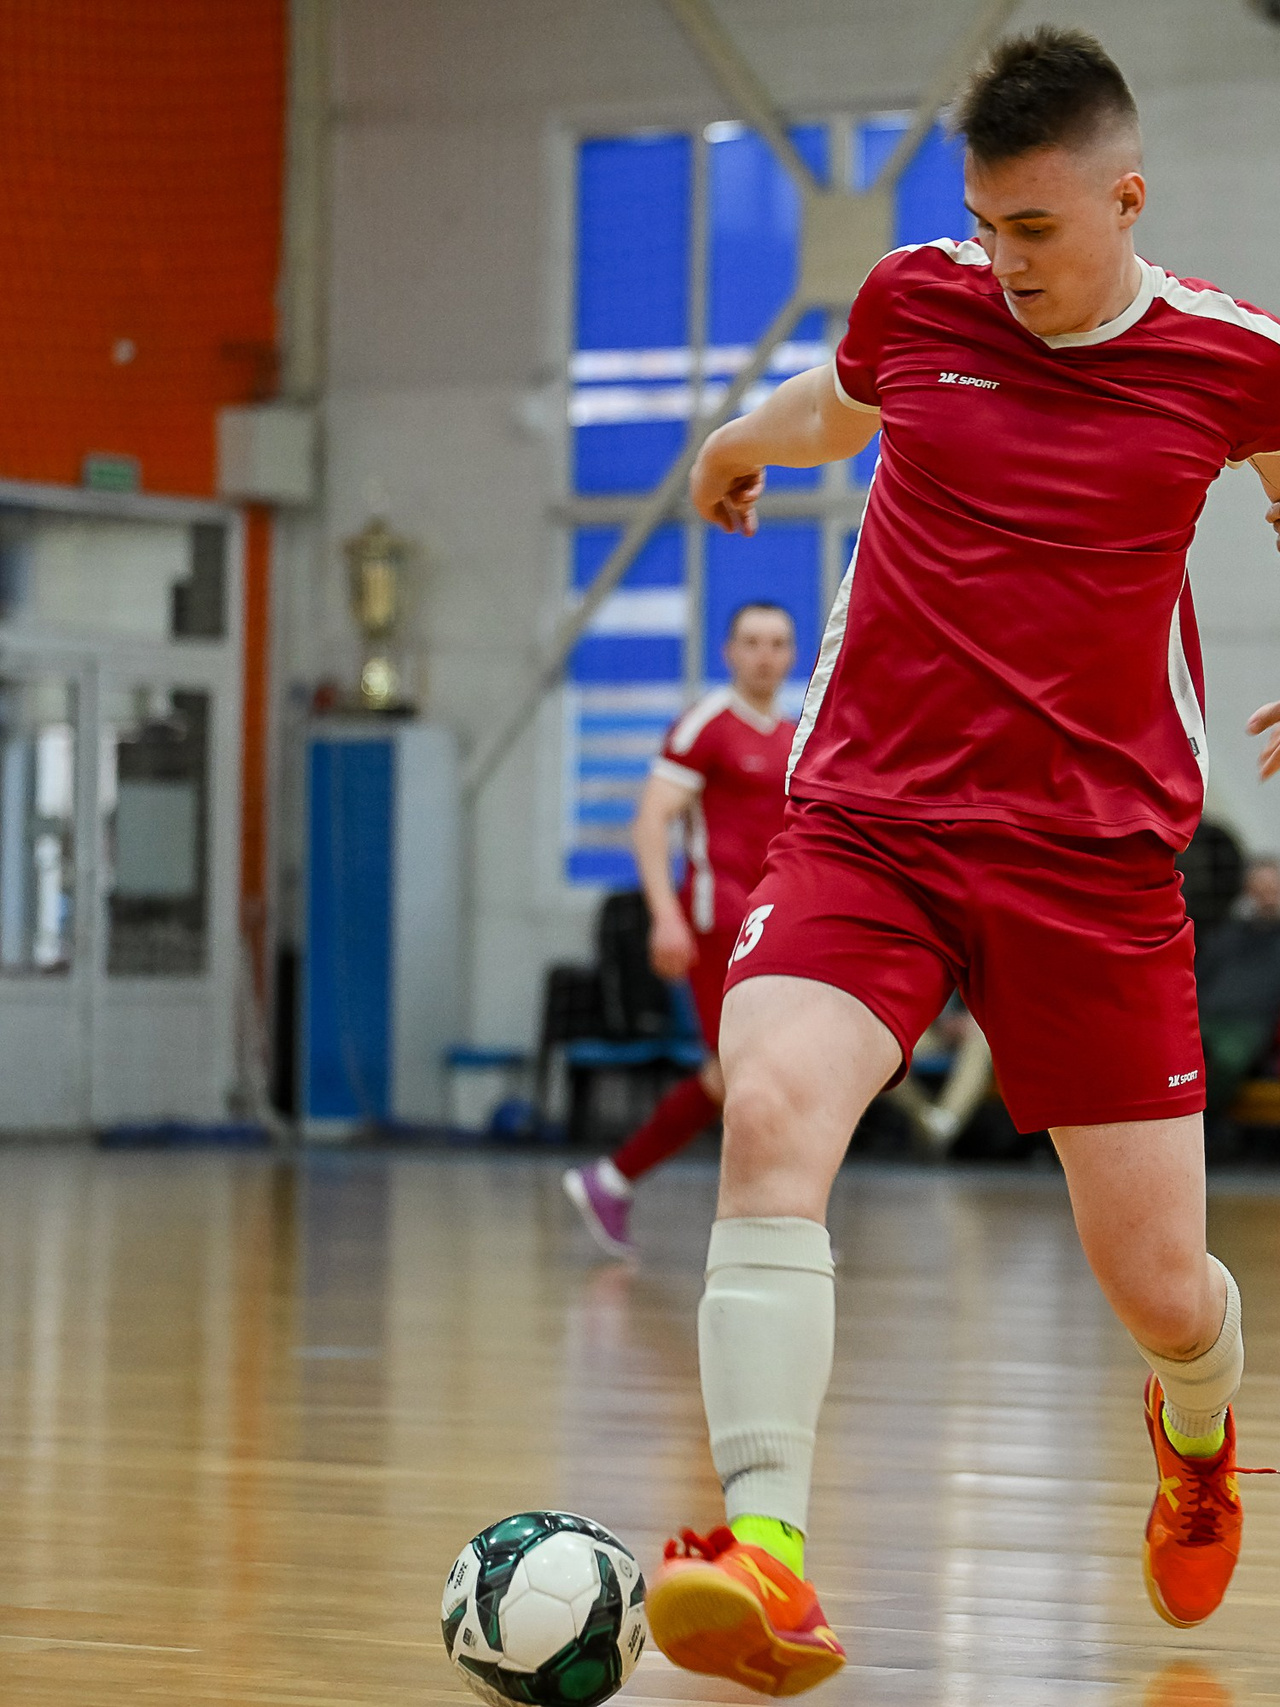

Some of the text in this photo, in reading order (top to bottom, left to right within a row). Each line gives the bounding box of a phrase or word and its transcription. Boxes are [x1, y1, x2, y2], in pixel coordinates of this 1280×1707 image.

[937, 372, 1000, 390] 2K SPORT
[1180, 1070, 1198, 1084] SPORT
